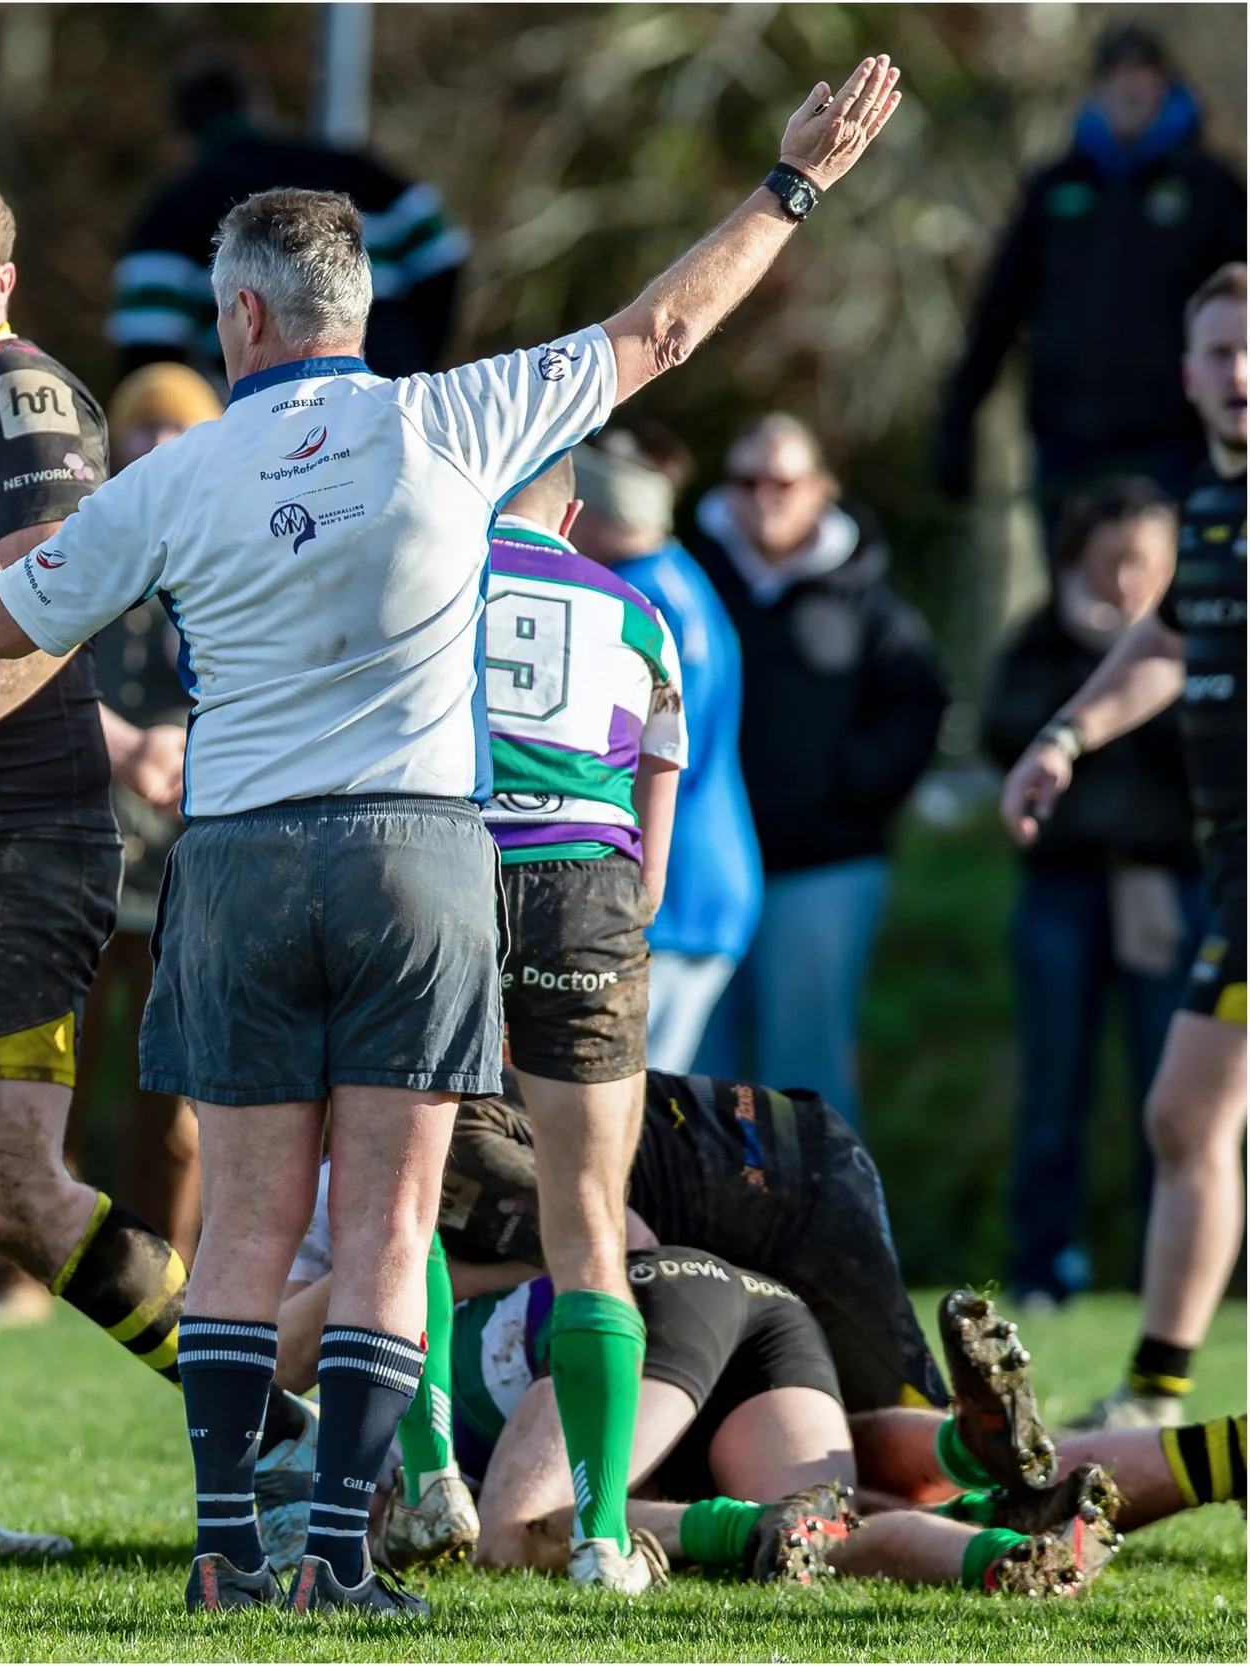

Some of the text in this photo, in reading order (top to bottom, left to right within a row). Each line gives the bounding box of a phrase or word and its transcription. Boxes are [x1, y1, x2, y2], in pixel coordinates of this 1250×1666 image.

[3, 469, 74, 492] NETWORK
[318, 503, 365, 520] MARSHALLING
[343, 510, 366, 521] MINDS
[486, 589, 572, 721] 9
